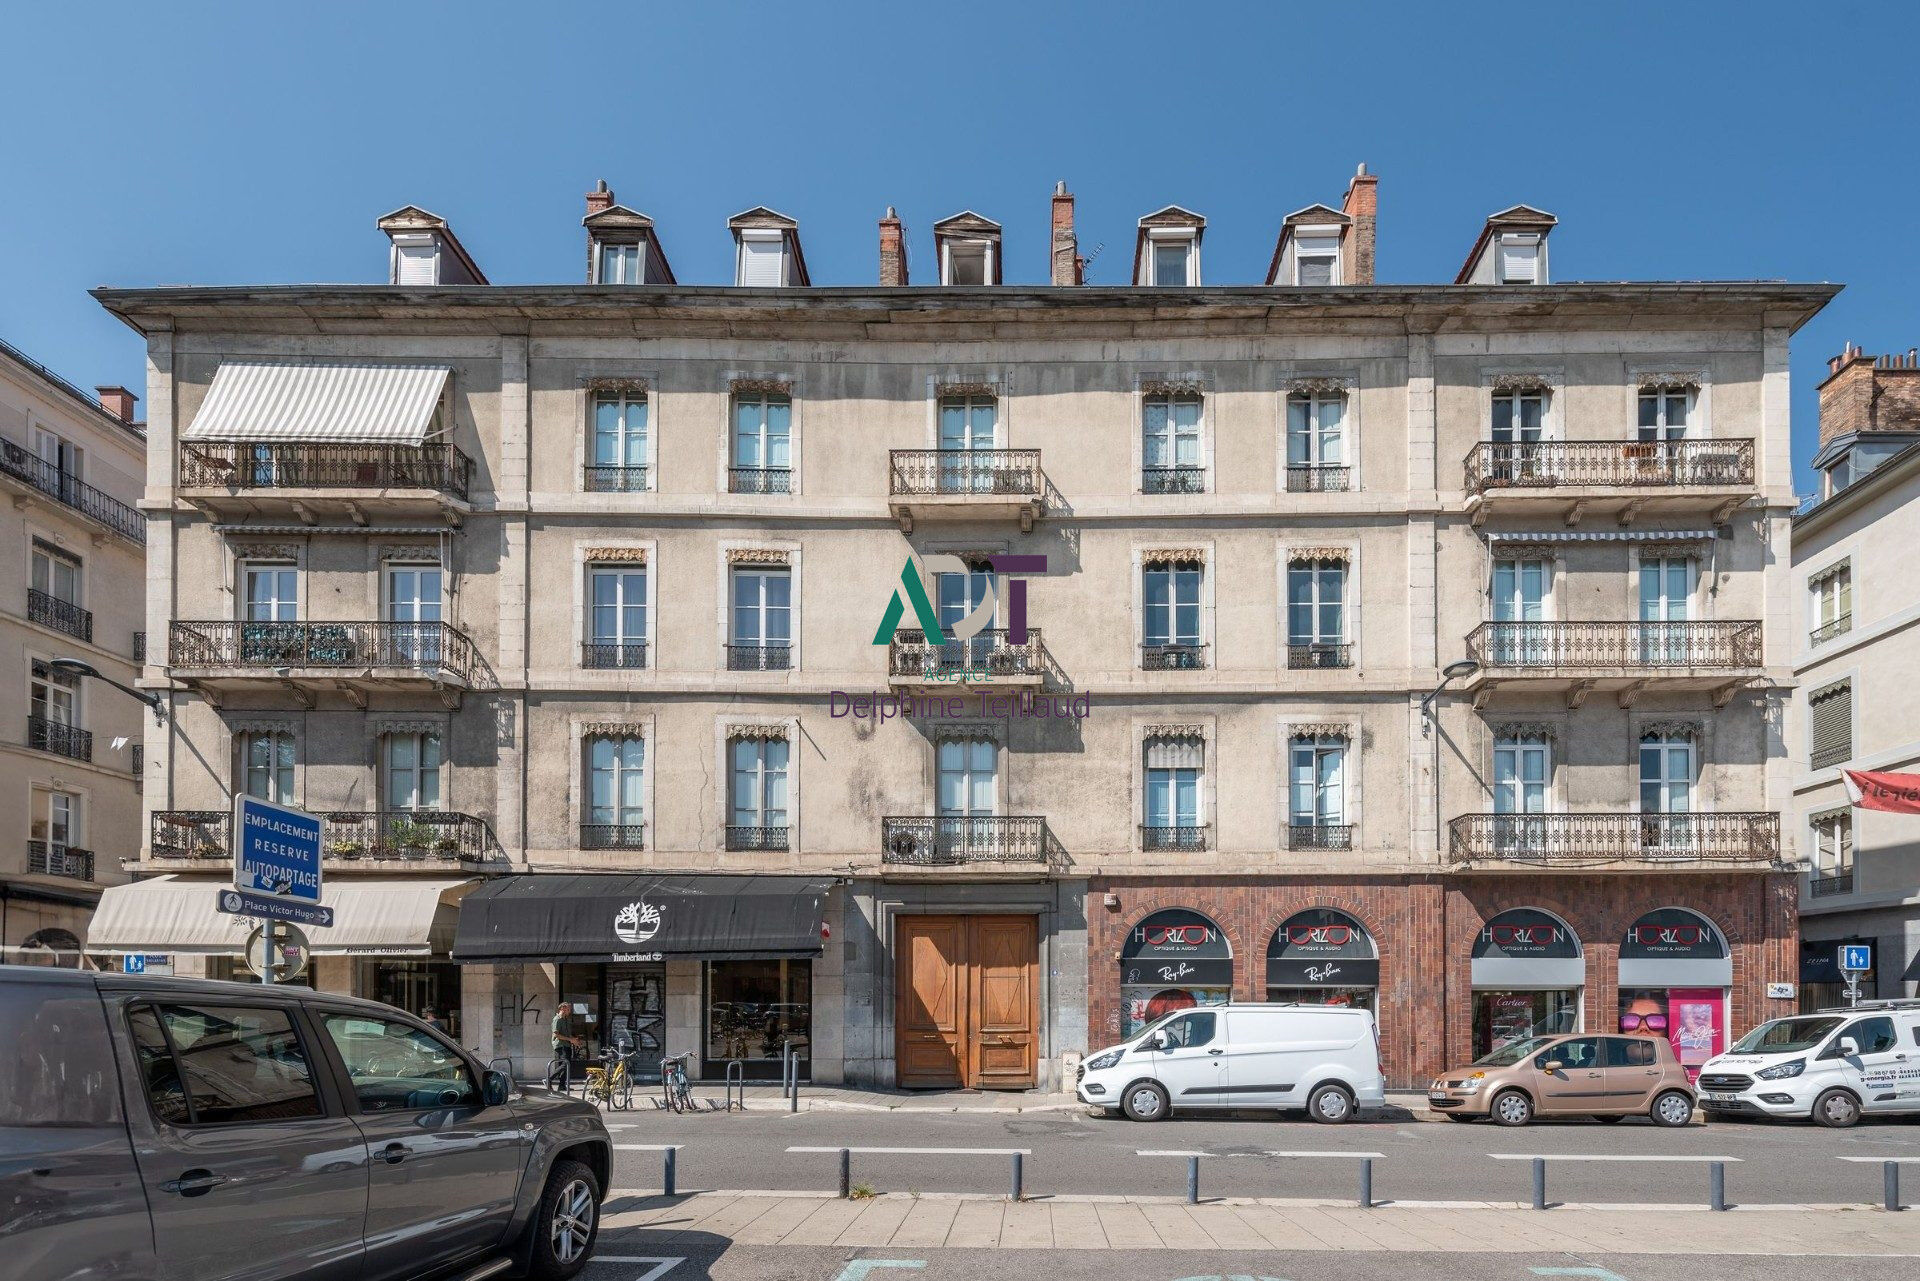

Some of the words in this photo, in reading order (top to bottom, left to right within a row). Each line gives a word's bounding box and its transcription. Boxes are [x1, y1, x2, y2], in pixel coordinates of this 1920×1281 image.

[245, 812, 318, 842] EMPLACEMENT
[255, 838, 309, 861] RESERVE
[245, 860, 318, 888] AUTOPARTAGE
[244, 900, 267, 912] Place
[269, 904, 293, 916] Victor
[295, 908, 315, 919] Hugo
[1134, 925, 1217, 945] HORIZON
[1278, 925, 1360, 945] HORIZON
[1482, 925, 1564, 944] HORIZON
[1627, 925, 1710, 944] HORIZON
[380, 944, 408, 954] Olivier
[612, 952, 652, 962] Timberland
[1158, 962, 1195, 981] Ray-Ban
[1304, 962, 1341, 981] Ray-Ban
[1496, 996, 1527, 1007] Cartier
